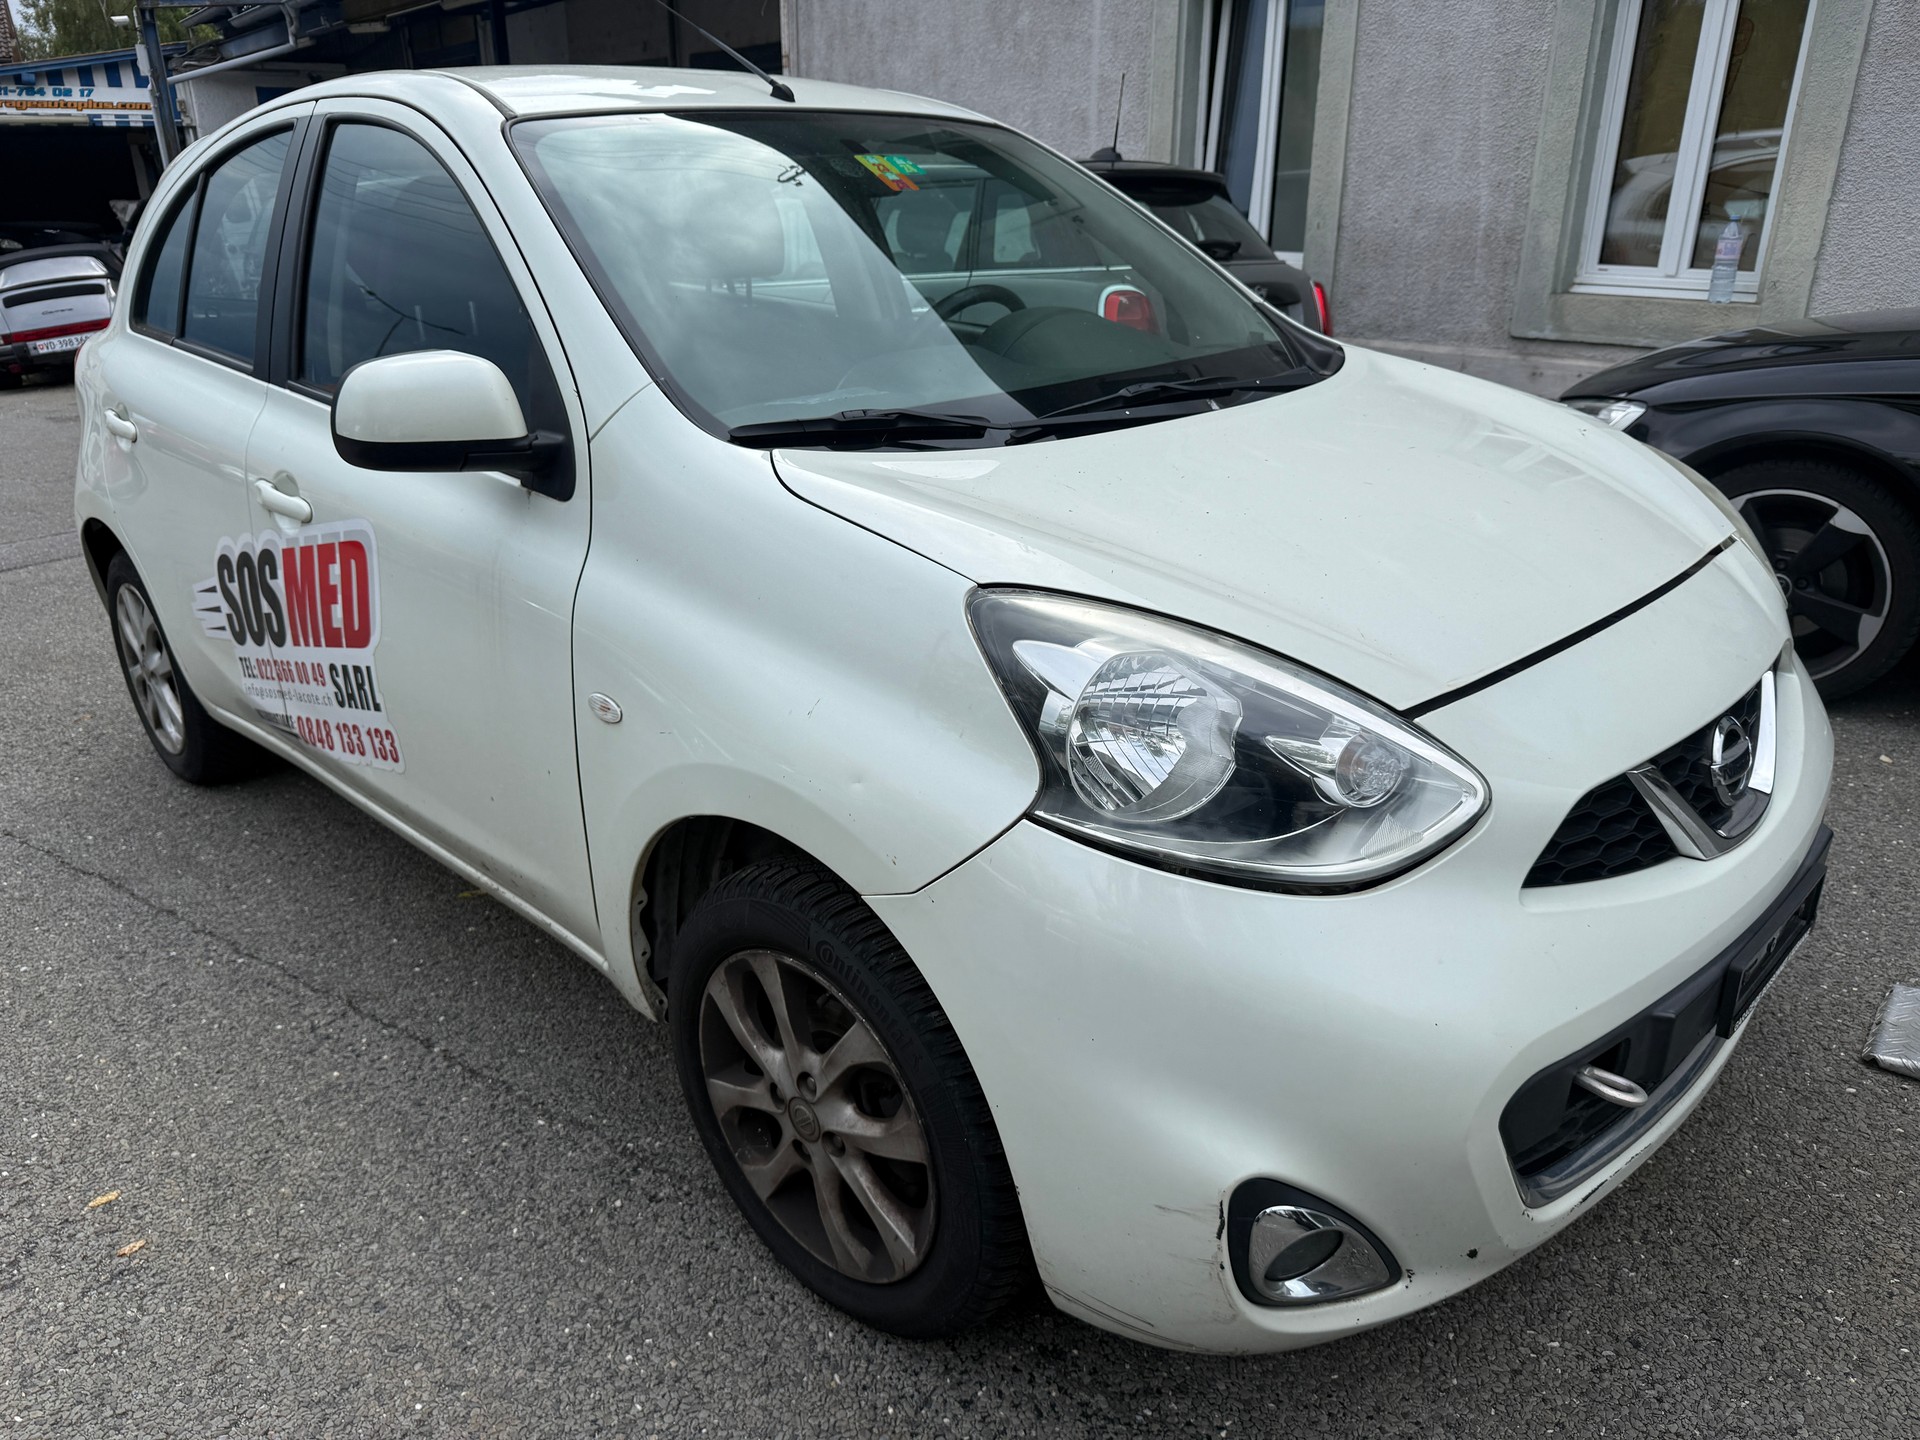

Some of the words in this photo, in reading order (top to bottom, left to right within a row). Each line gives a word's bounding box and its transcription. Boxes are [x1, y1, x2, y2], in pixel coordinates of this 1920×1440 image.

[52, 87, 73, 97] 02
[79, 87, 95, 98] 17
[273, 658, 295, 684] 366
[294, 660, 311, 686] 00
[310, 661, 327, 688] 49
[328, 662, 383, 713] SARL
[296, 715, 336, 752] 0848
[335, 722, 367, 757] 133
[366, 727, 400, 763] 133
[815, 938, 914, 1051] Continental
